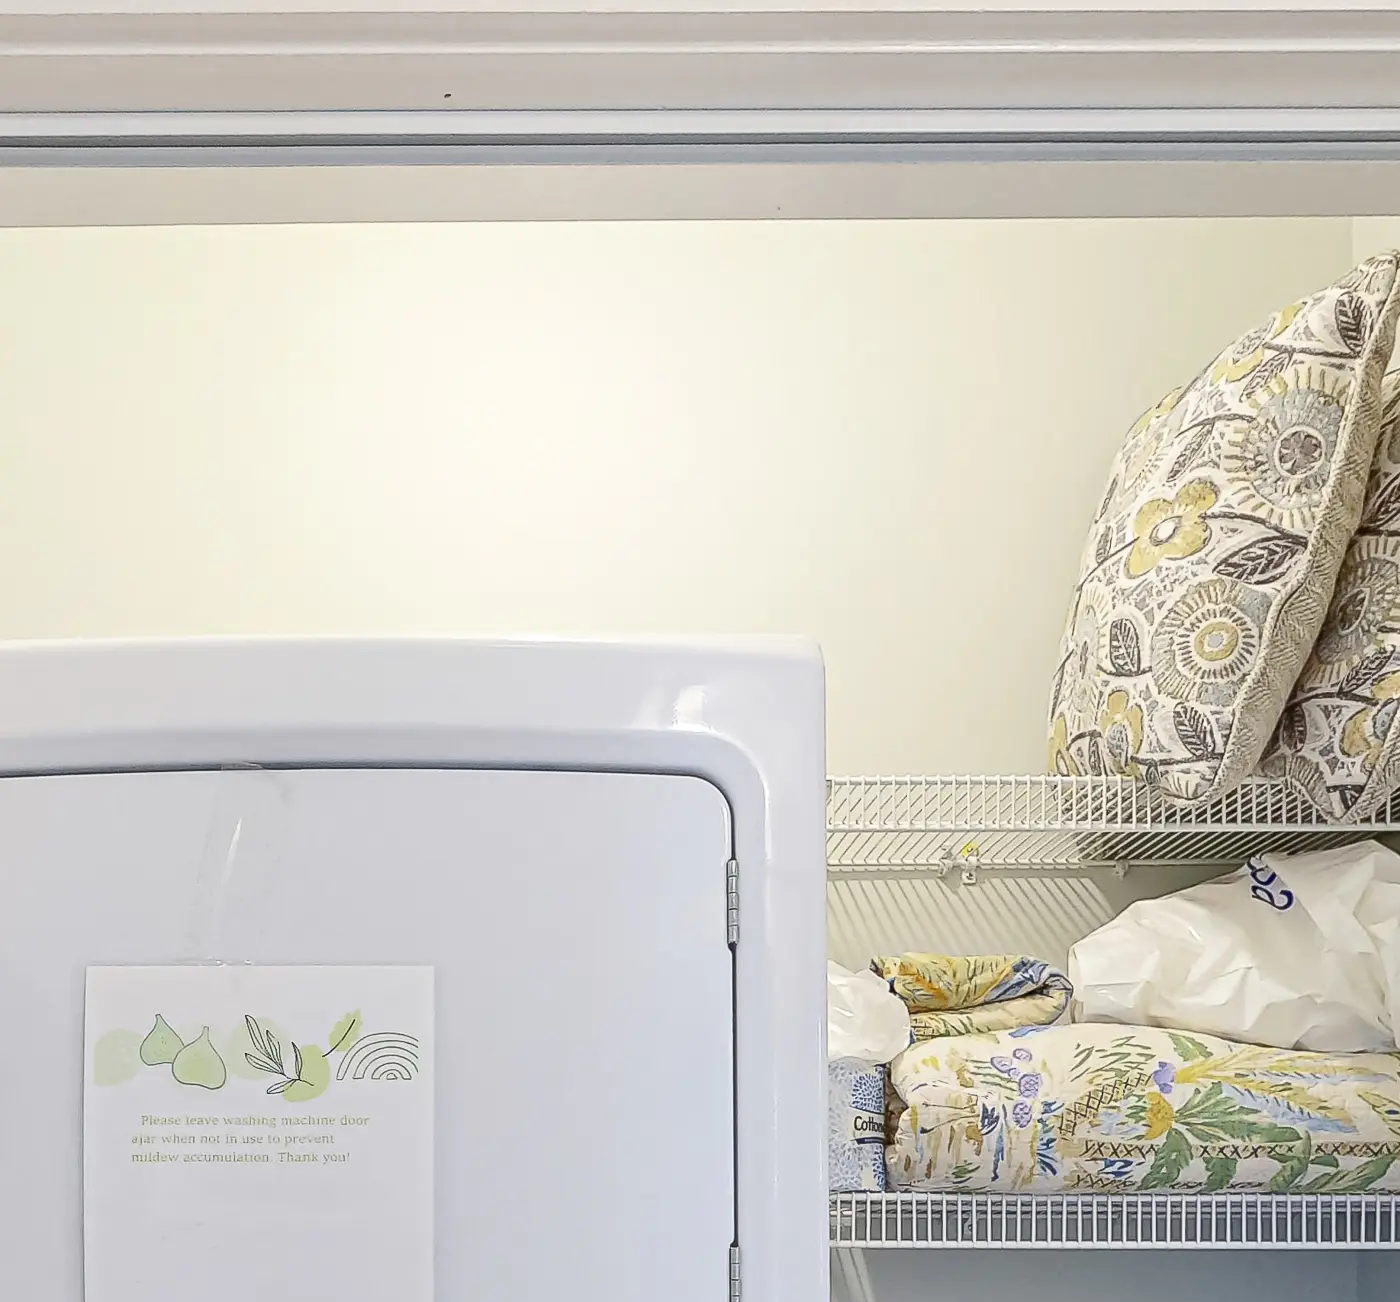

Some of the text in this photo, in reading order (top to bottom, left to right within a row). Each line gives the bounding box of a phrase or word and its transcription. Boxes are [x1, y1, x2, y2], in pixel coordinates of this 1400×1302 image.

[141, 1115, 370, 1128] Please leave washing machine door
[131, 1133, 335, 1146] ajar when not in use to prevent
[131, 1152, 179, 1163] mildew
[277, 1152, 318, 1163] Thank
